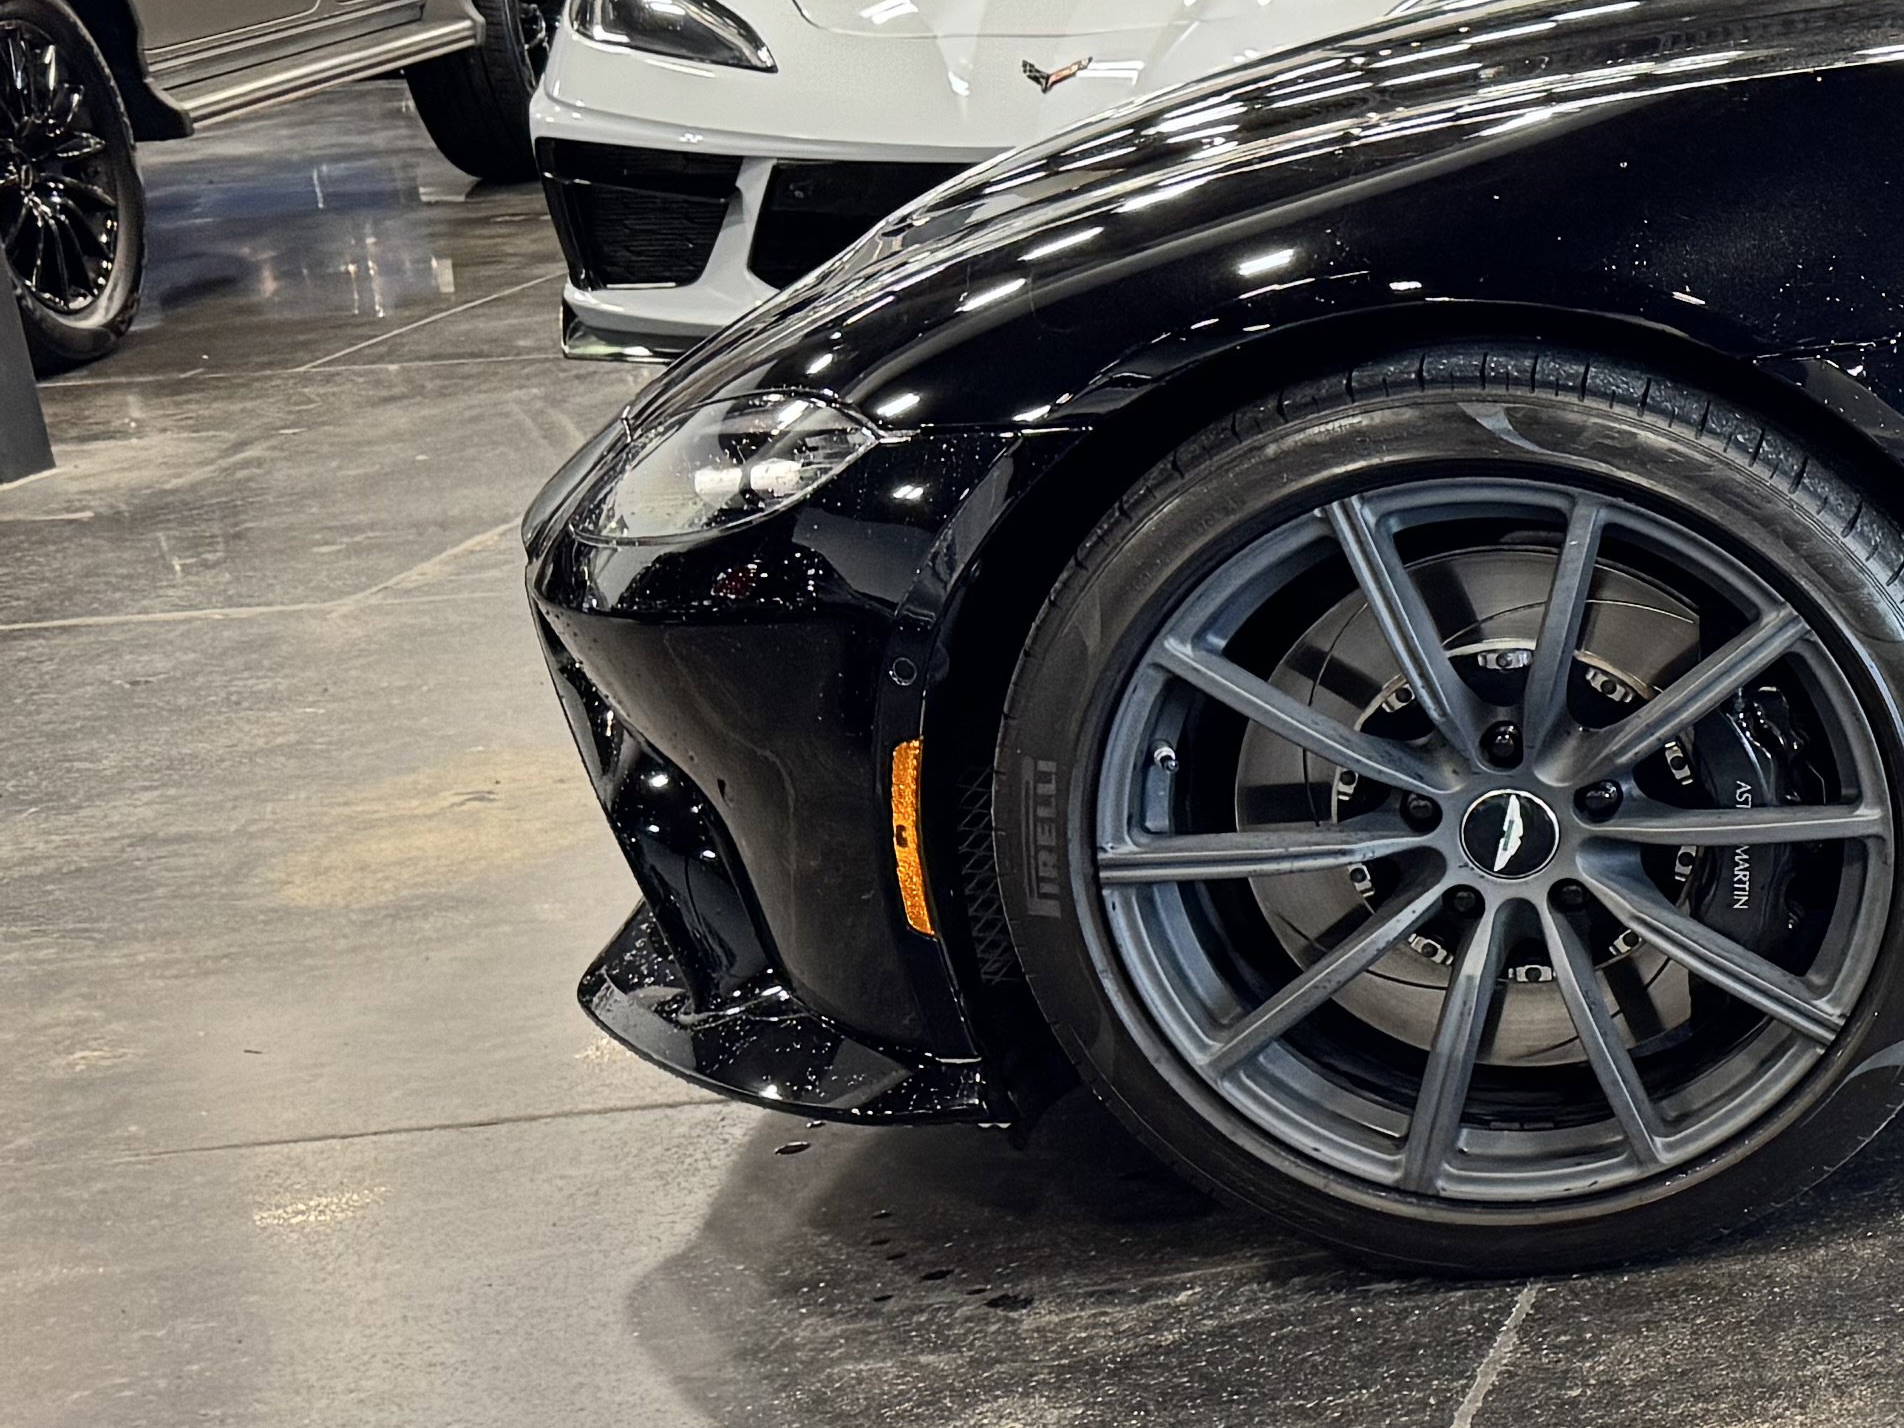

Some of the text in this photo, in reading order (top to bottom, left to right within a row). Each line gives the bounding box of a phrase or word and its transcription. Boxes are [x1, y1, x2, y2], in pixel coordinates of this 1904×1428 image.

[1021, 756, 1062, 918] PIRELLI
[1733, 780, 1752, 909] AST MARTIN
